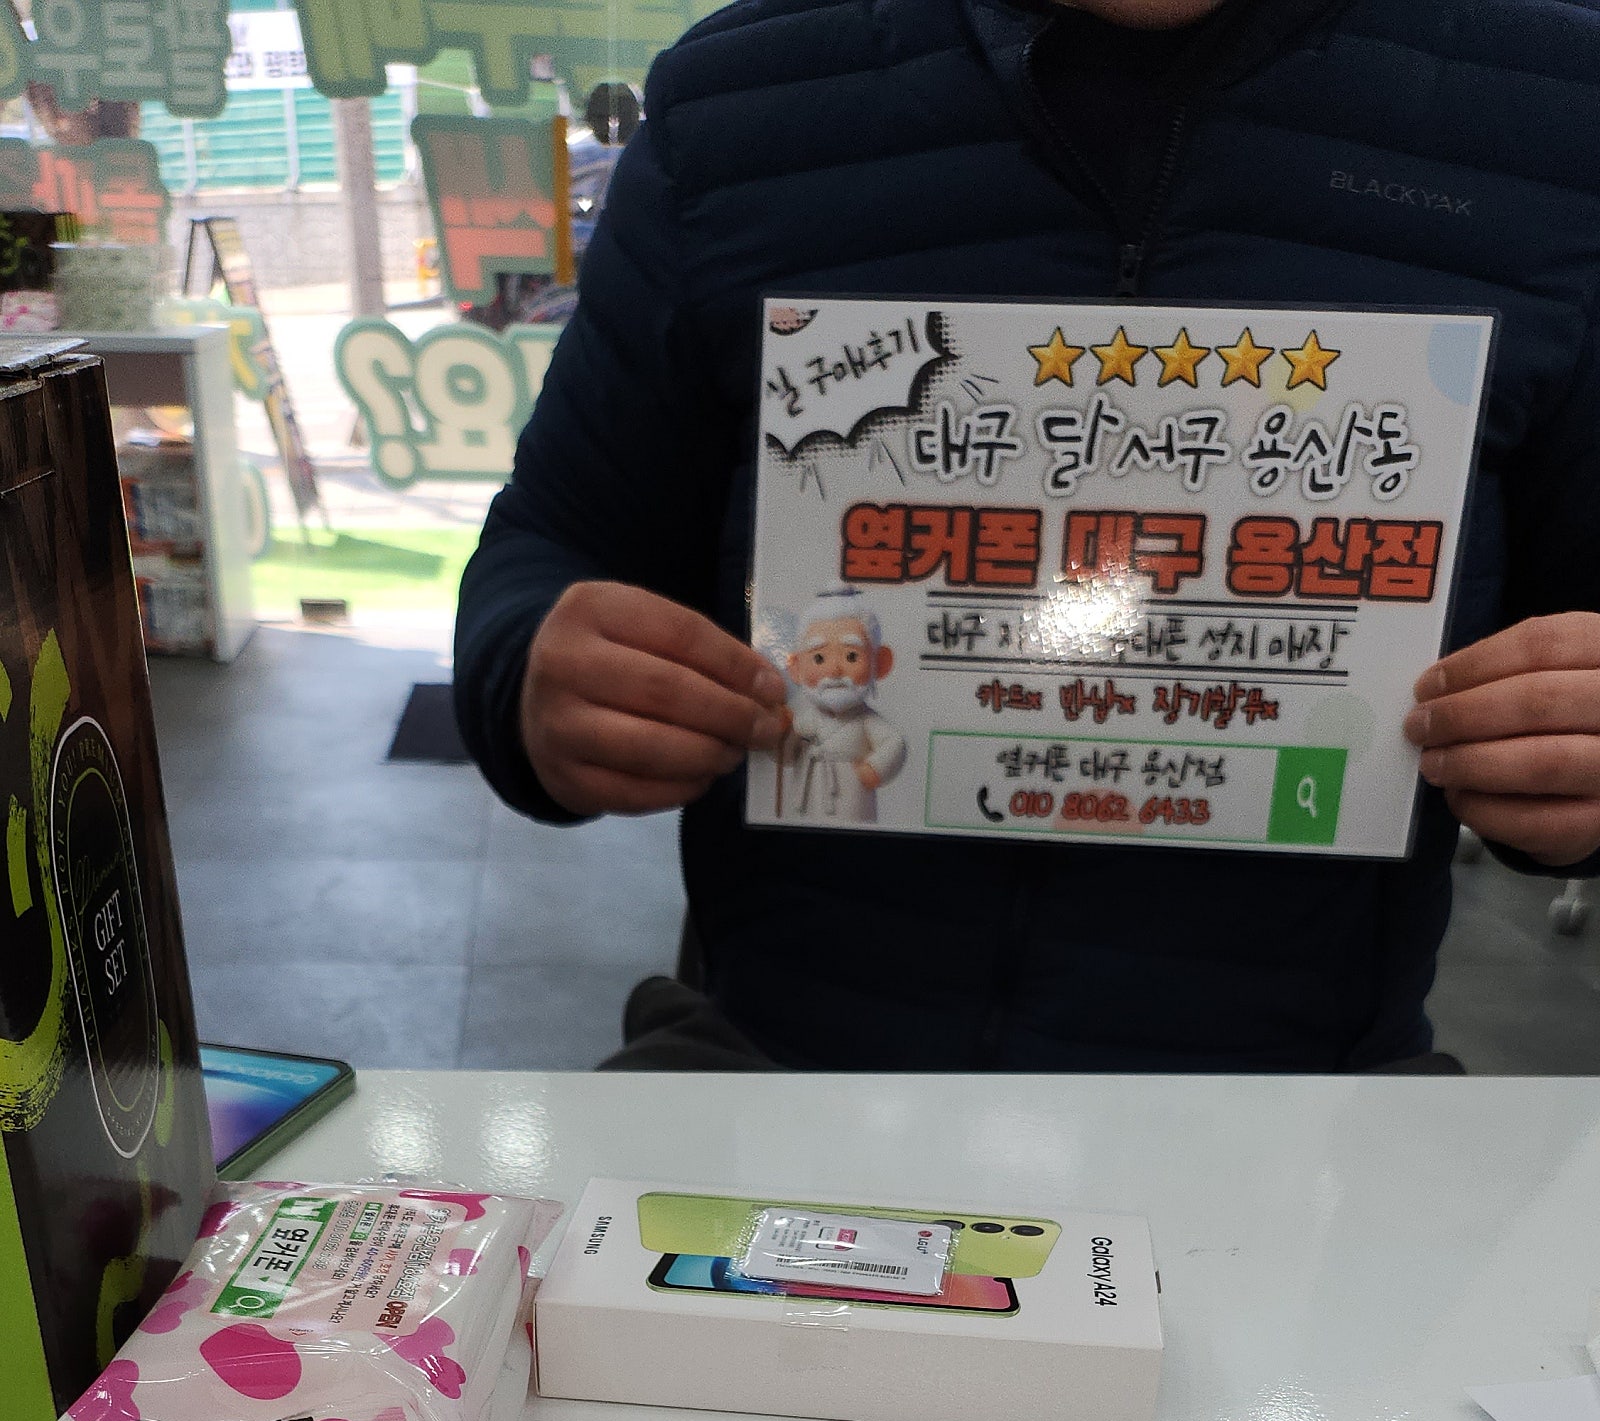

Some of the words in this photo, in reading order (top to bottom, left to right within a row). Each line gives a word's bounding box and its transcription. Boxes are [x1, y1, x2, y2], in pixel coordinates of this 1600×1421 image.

[1330, 170, 1473, 216] BLACKYAK
[766, 366, 804, 418] 실
[805, 317, 920, 396] 구매후기
[914, 406, 1018, 477] 대구
[1042, 399, 1227, 489] 달서구
[1247, 408, 1414, 494] 용산동
[841, 502, 1043, 588] 옆커폰
[1064, 509, 1208, 596] 대구
[1229, 515, 1444, 602] 용산점
[928, 613, 986, 651] 대구
[1203, 621, 1259, 661] 성지
[1269, 621, 1349, 669] 매장
[997, 743, 1071, 782] 옆커폰
[1080, 749, 1132, 784] 대구
[1141, 748, 1227, 788] 용산점
[1008, 789, 1054, 817] 010
[1061, 790, 1131, 822] 8062
[1138, 795, 1211, 825] 6433
[94, 889, 125, 951] GIFT
[105, 938, 128, 996] SET
[253, 1228, 309, 1271] 옆커폰
[584, 1215, 613, 1256] SAMSUNG
[918, 1237, 930, 1246] LG
[1086, 1236, 1114, 1282] Galaxy
[376, 1301, 408, 1329] OPEN
[1093, 1281, 1117, 1306] A24
